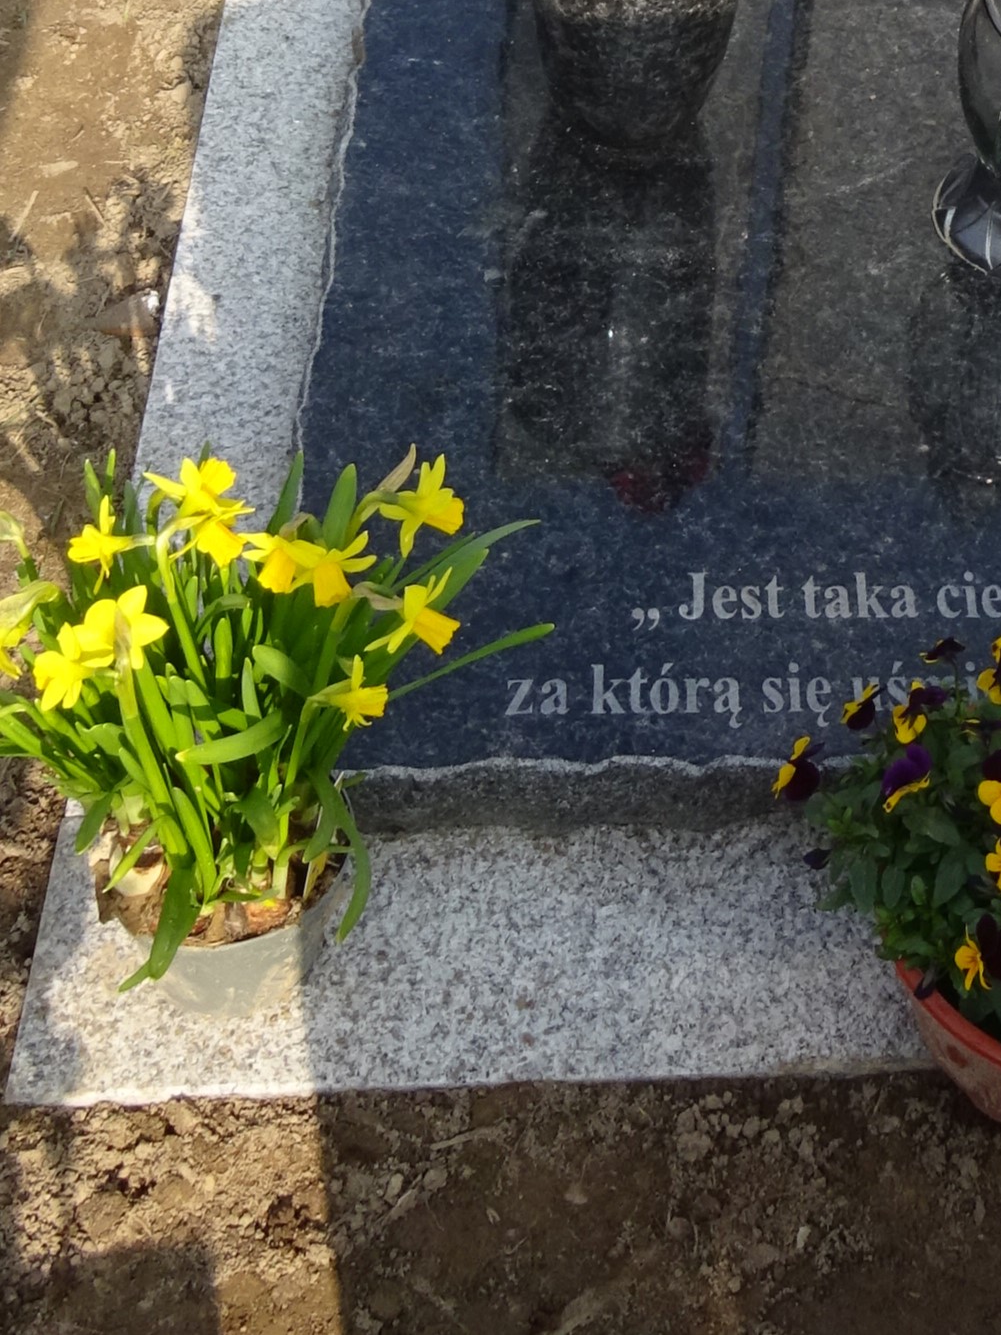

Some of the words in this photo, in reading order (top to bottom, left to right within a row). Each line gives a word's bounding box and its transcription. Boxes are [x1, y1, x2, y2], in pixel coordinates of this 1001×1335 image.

[802, 572, 919, 619] taka
[504, 677, 571, 716] za
[590, 662, 744, 729] którą
[760, 664, 833, 728] się
